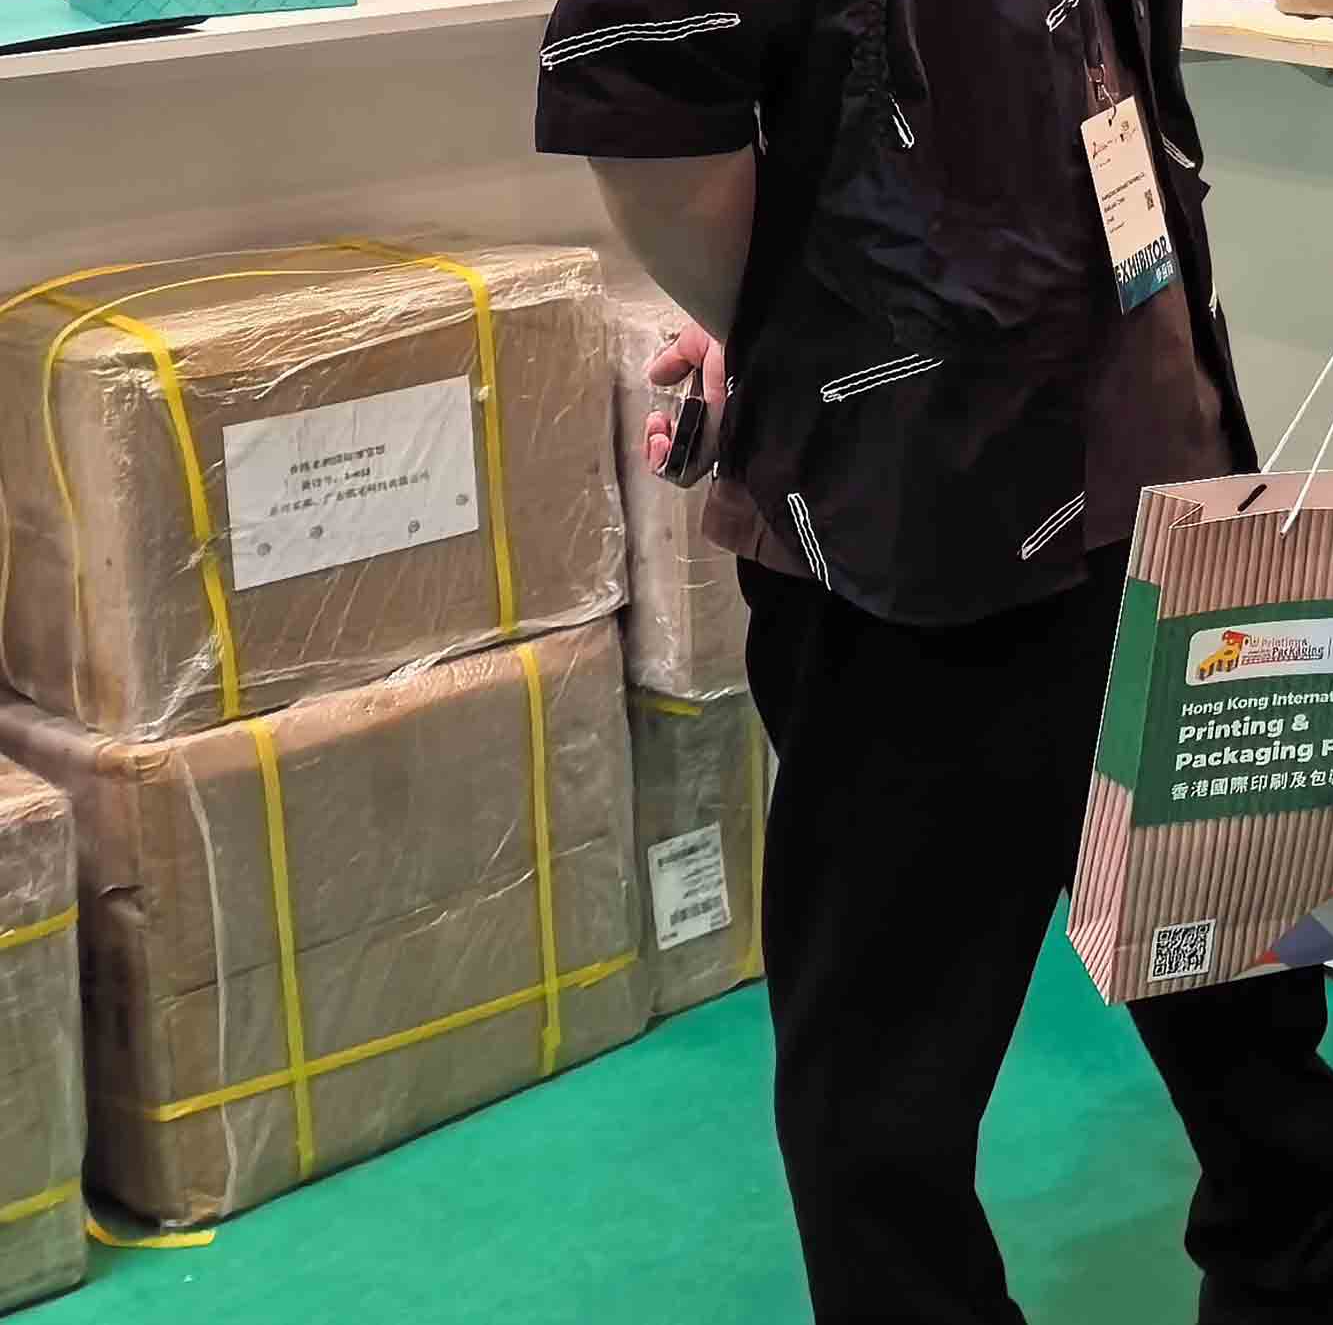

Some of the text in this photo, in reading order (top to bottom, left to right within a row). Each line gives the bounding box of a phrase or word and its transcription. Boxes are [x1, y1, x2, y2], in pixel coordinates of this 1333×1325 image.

[1181, 700, 1223, 716] Hong
[1227, 695, 1268, 711] Kong
[1178, 713, 1310, 744] Printing &
[1175, 740, 1314, 771] Packaging
